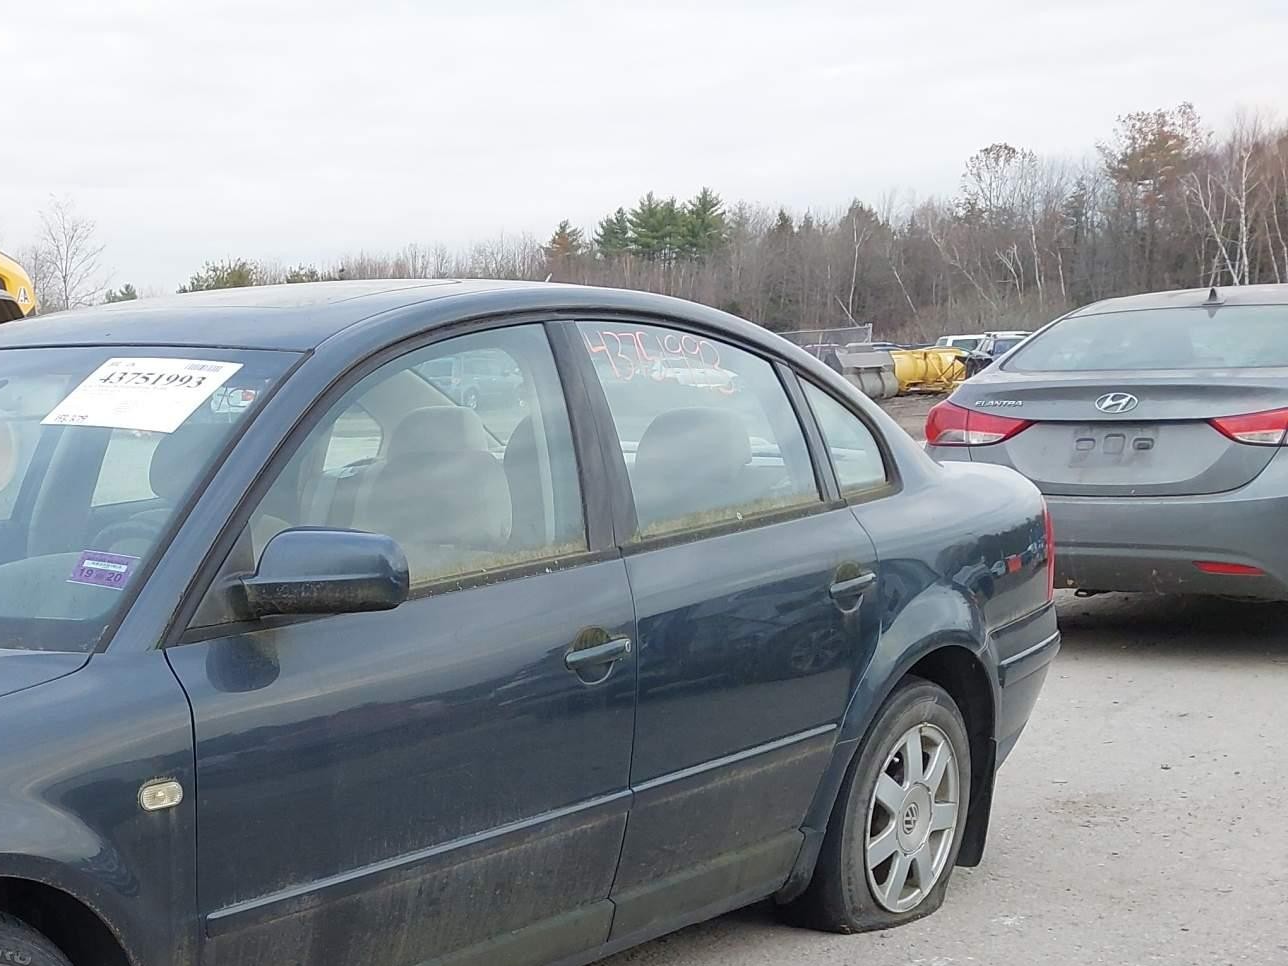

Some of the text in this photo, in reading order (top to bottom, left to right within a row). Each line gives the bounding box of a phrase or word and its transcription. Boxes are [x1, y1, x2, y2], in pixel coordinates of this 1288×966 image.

[99, 371, 207, 389] 43751993
[975, 399, 1024, 408] ELANTRA
[79, 568, 123, 582] 19 20
